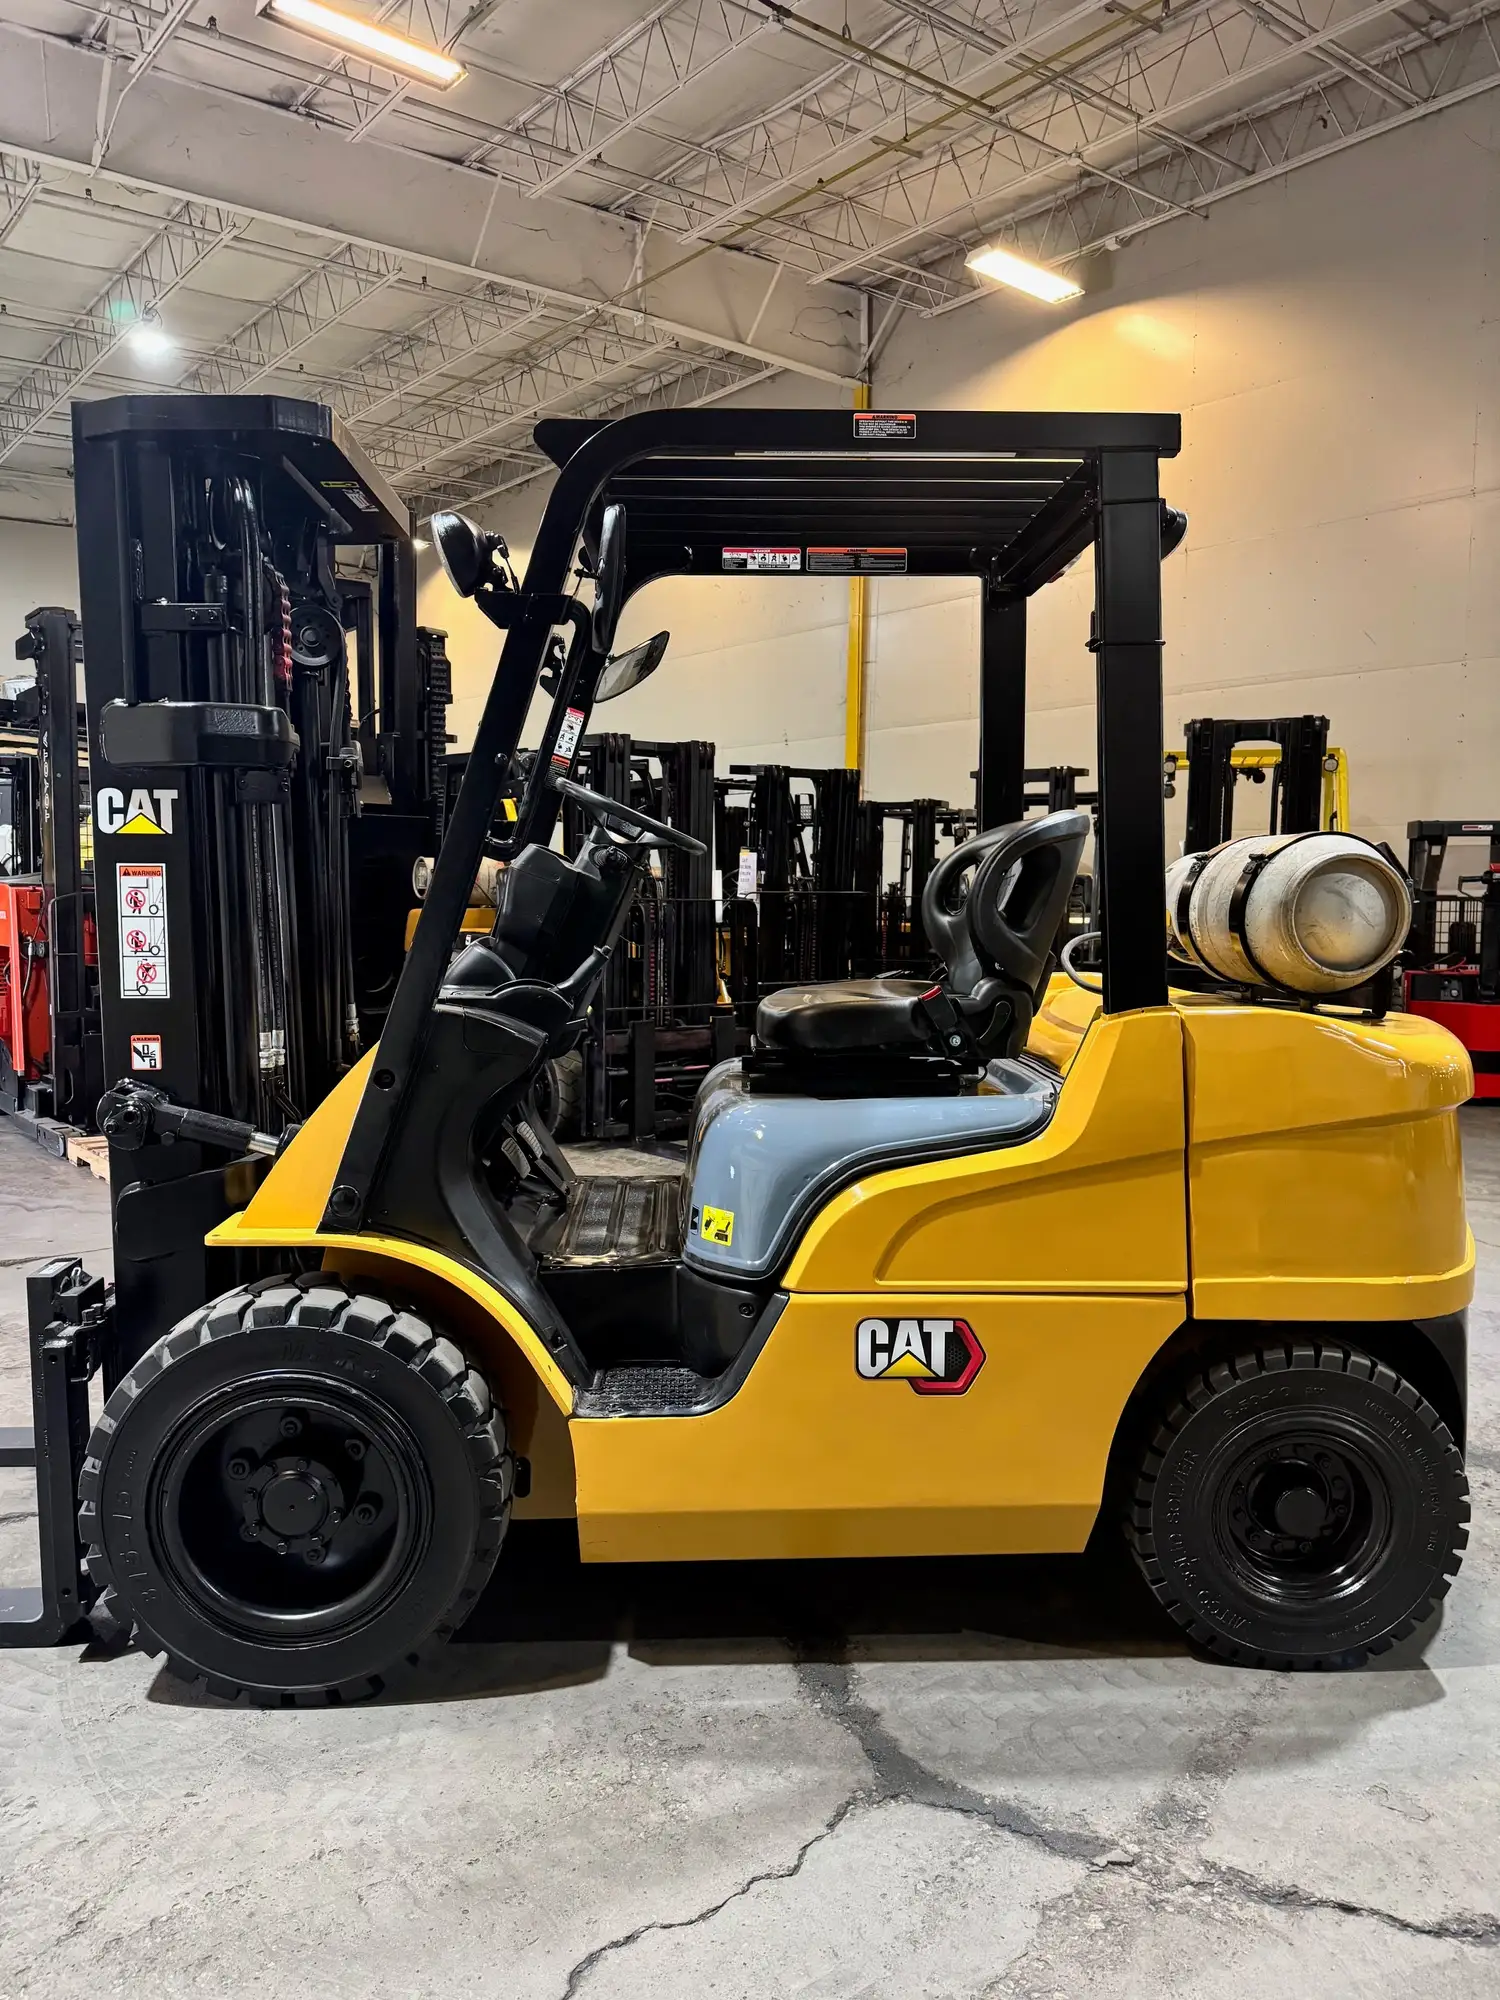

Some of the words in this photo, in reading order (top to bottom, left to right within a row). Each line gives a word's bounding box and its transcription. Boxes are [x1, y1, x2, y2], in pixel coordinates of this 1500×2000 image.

[43, 730, 51, 823] TOYOTA
[97, 787, 179, 835] CAT
[858, 1319, 954, 1378] CAT
